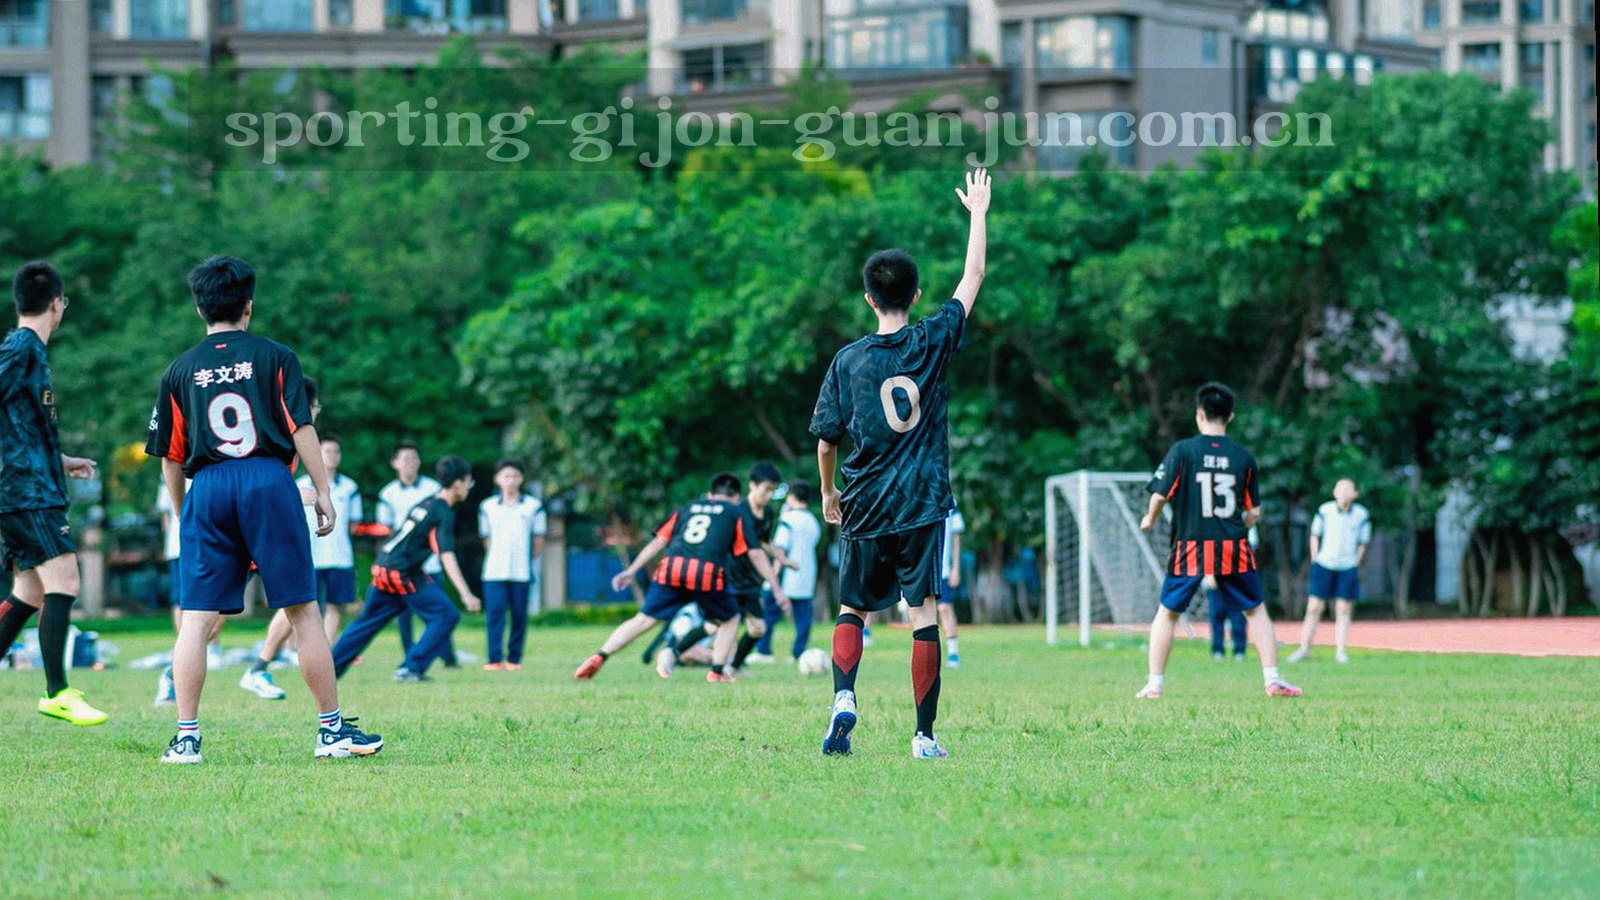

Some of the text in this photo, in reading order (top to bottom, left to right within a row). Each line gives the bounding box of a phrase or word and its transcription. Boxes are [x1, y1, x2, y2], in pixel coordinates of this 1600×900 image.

[194, 361, 253, 388] 李文涛
[208, 392, 258, 458] 9
[880, 375, 921, 433] 0
[1196, 472, 1236, 519] 13
[683, 514, 711, 544] 8
